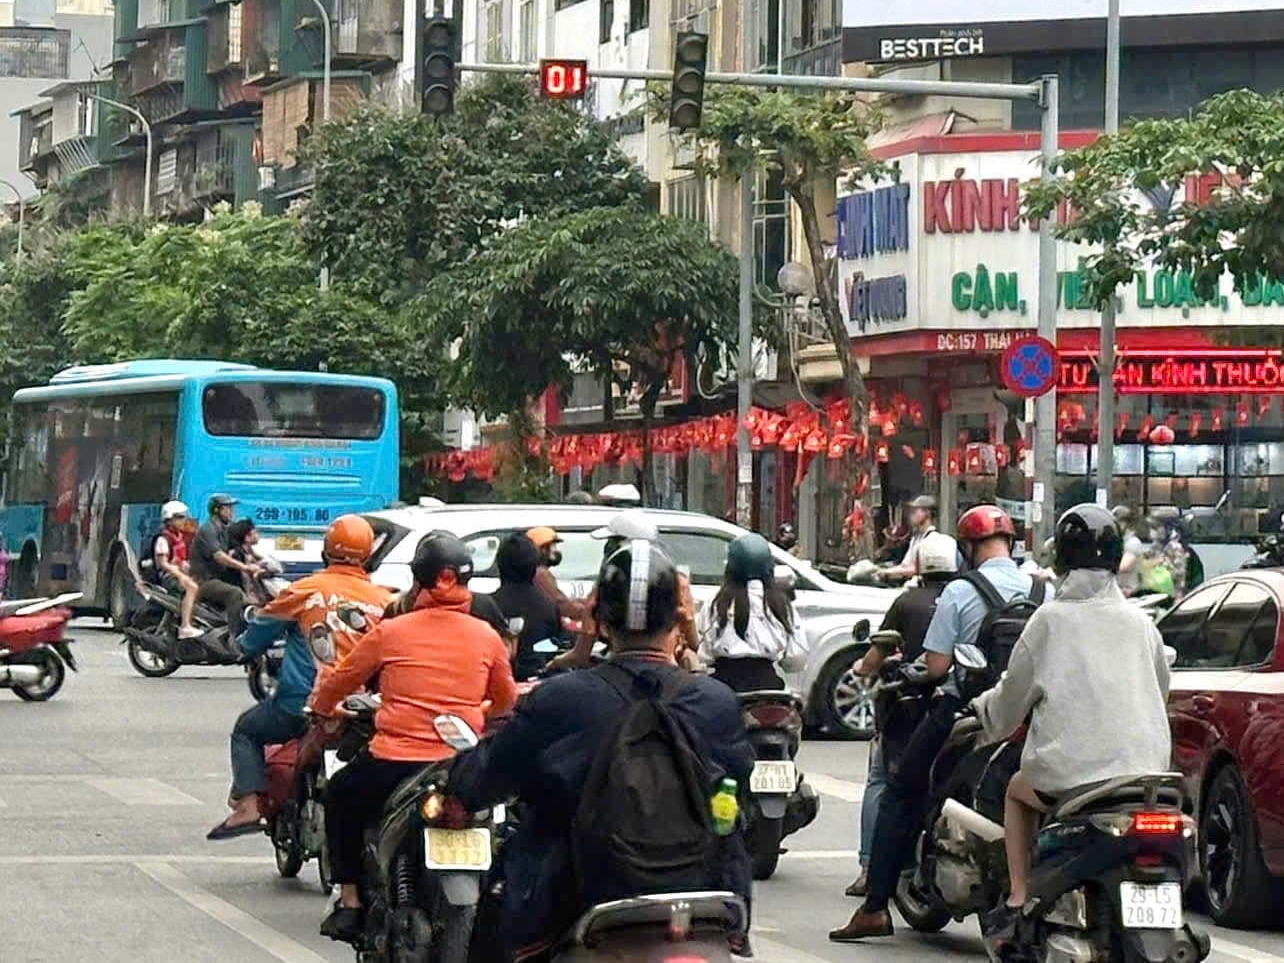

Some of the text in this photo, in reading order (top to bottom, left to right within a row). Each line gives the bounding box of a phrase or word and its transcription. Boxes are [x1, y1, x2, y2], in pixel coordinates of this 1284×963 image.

[881, 37, 984, 58] BESTTECH
[547, 65, 581, 93] 01
[924, 167, 1020, 234] KÍNH
[952, 264, 1028, 318] CẬN,
[1151, 357, 1207, 386] KÍNH
